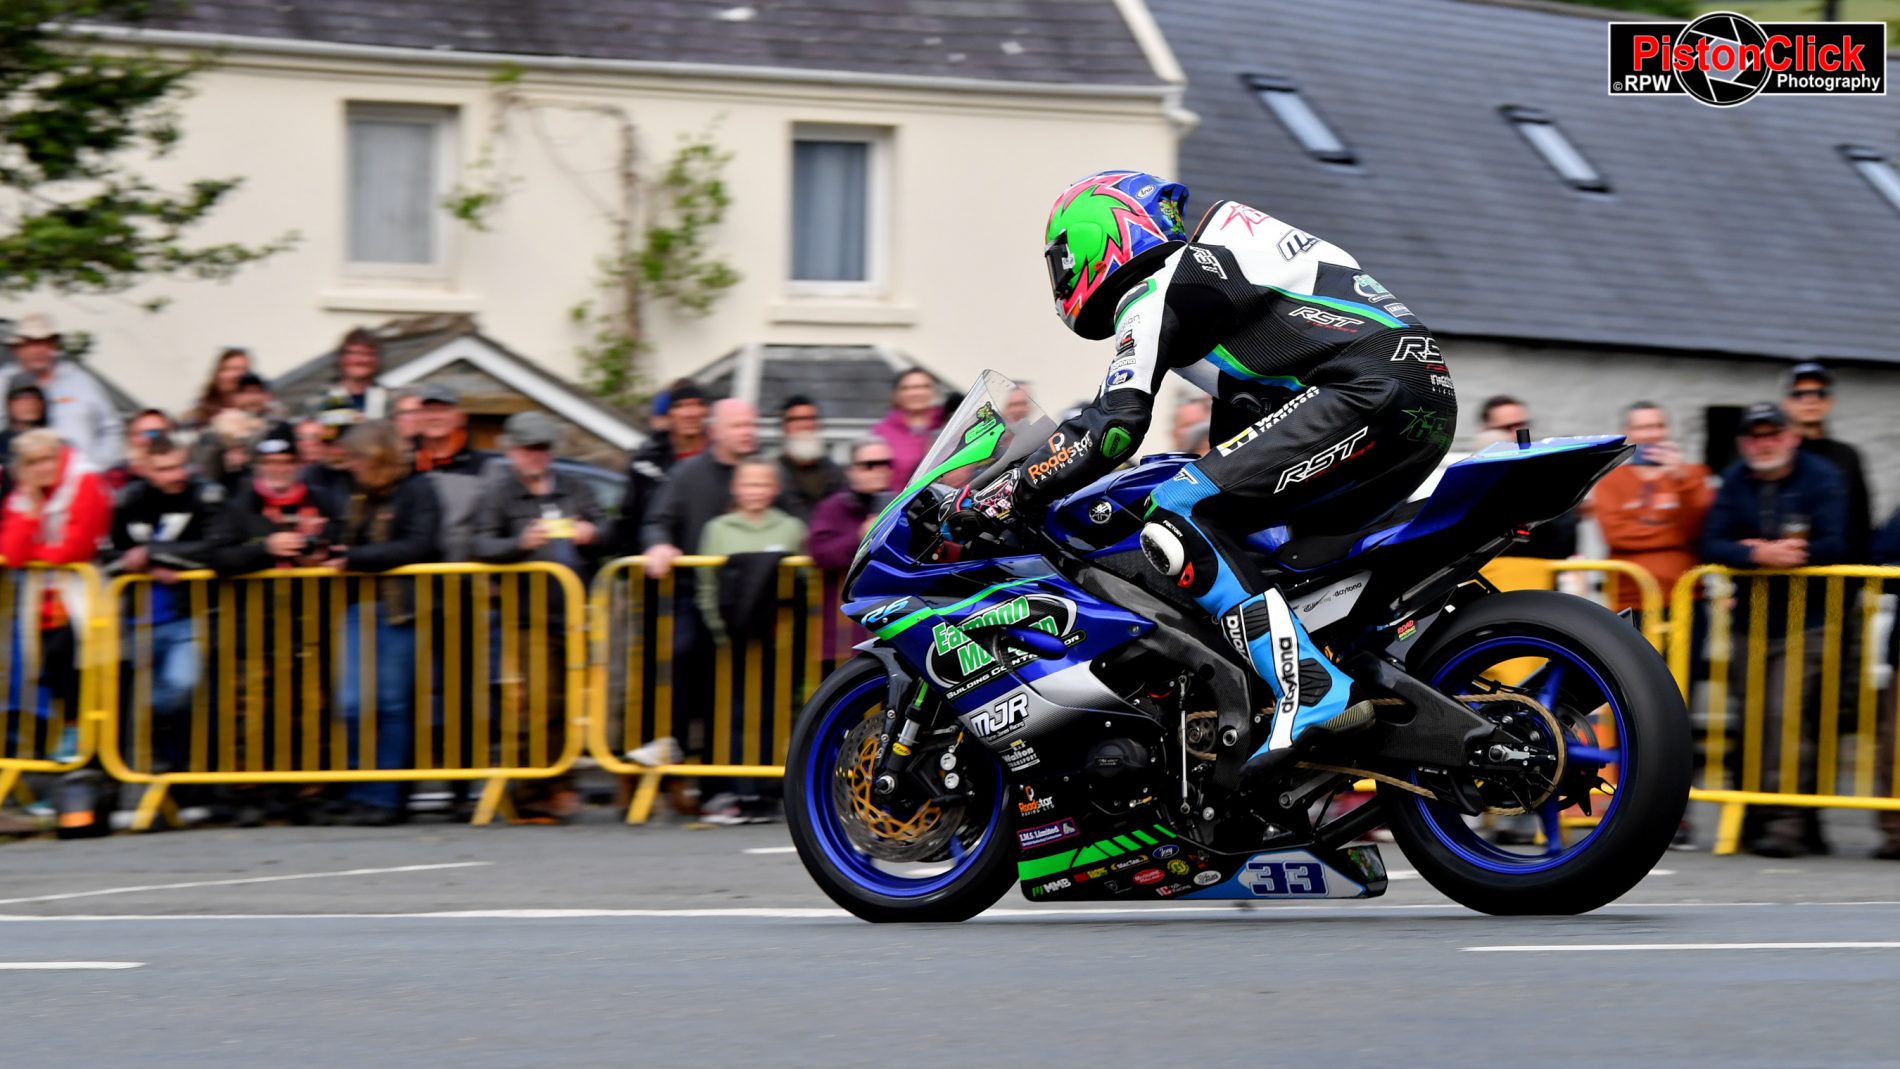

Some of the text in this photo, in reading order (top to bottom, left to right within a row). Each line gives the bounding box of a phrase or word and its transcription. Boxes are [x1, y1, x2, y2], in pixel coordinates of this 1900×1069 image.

[1189, 245, 1229, 280] RST
[1288, 306, 1365, 328] RST
[1028, 430, 1092, 481] Roadstar
[1033, 458, 1073, 485] PAVING
[1273, 425, 1369, 494] RST
[1279, 636, 1298, 714] daytona
[970, 693, 1028, 738] MJR
[1002, 746, 1034, 763] Walton
[1008, 753, 1038, 768] TRANSPORT
[1018, 795, 1053, 813] Roadstar
[1246, 860, 1328, 896] 33
